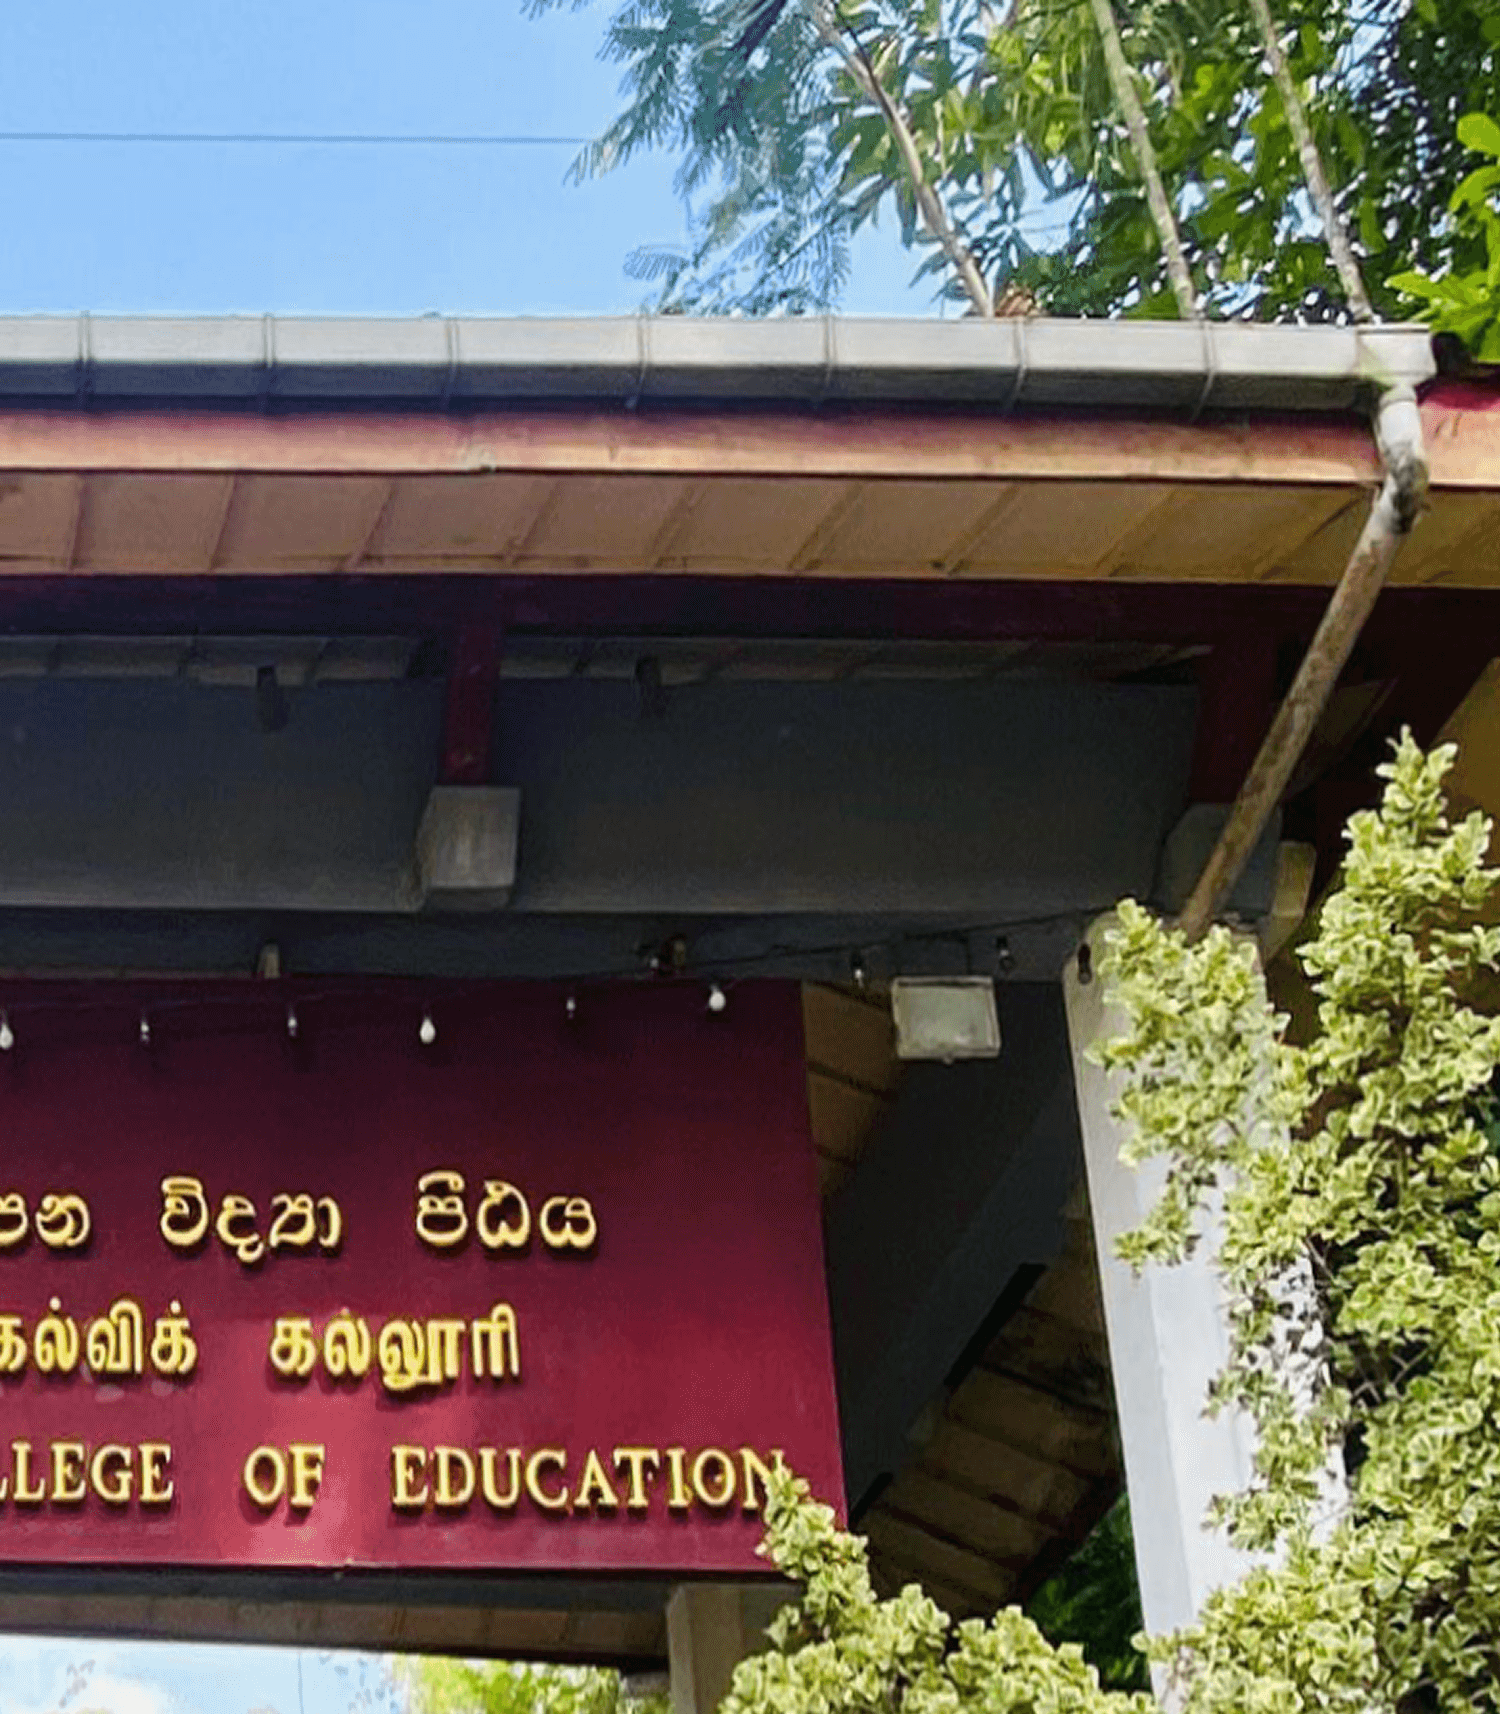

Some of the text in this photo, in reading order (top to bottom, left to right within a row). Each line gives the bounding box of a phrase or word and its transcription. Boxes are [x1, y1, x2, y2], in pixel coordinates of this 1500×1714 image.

[414, 1169, 598, 1249] පීඨය
[242, 1442, 327, 1508] OF
[390, 1443, 787, 1510] EDUCATION
